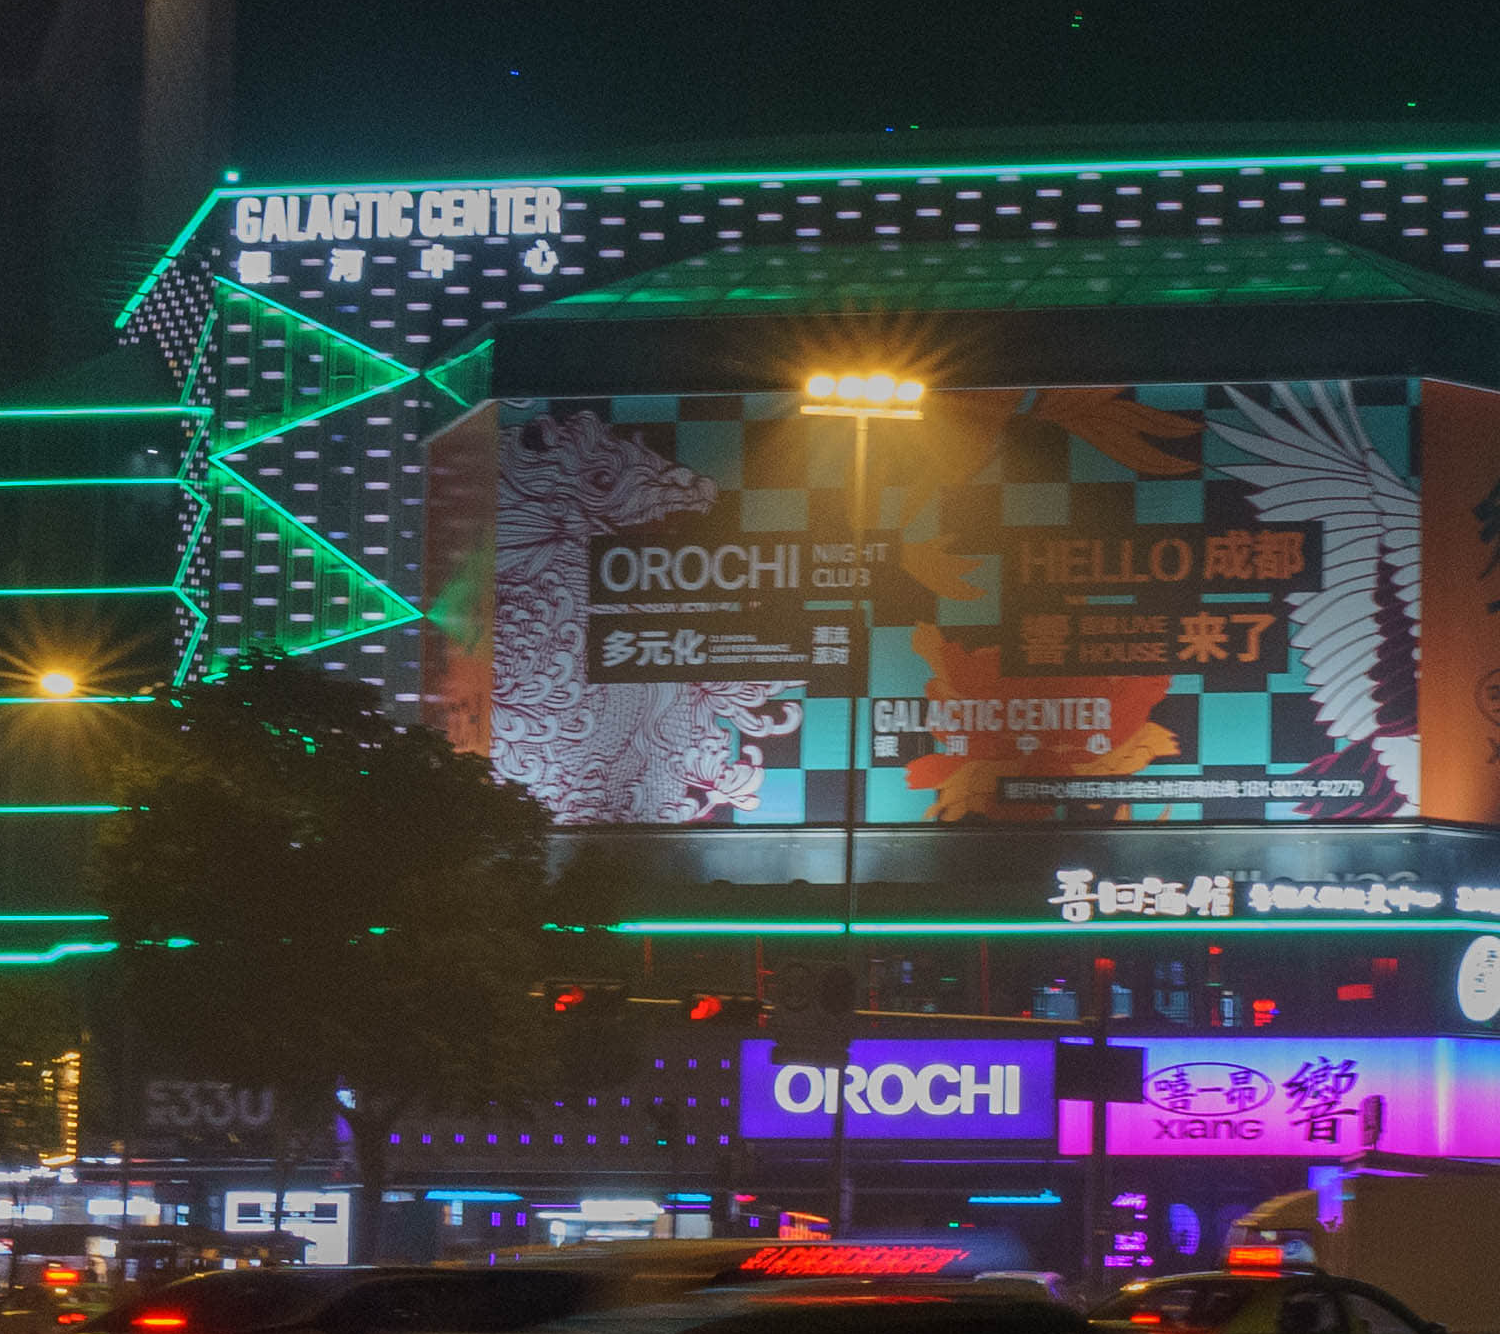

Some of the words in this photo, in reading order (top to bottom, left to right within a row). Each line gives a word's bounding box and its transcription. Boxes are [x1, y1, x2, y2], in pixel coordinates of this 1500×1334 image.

[236, 191, 414, 243] GALACTIC
[419, 187, 562, 237] CENTER
[601, 544, 799, 592] OROCHI
[812, 543, 889, 564] NIGHT
[1019, 537, 1193, 584] HELLO
[1204, 530, 1306, 580] 成都
[602, 628, 708, 667] 多元化
[1078, 642, 1169, 663] HOUSE
[1176, 611, 1276, 663] 来了
[873, 699, 1001, 732] GALACTIC
[1006, 697, 1112, 731] CENTER
[774, 1063, 1020, 1115] OROCHI
